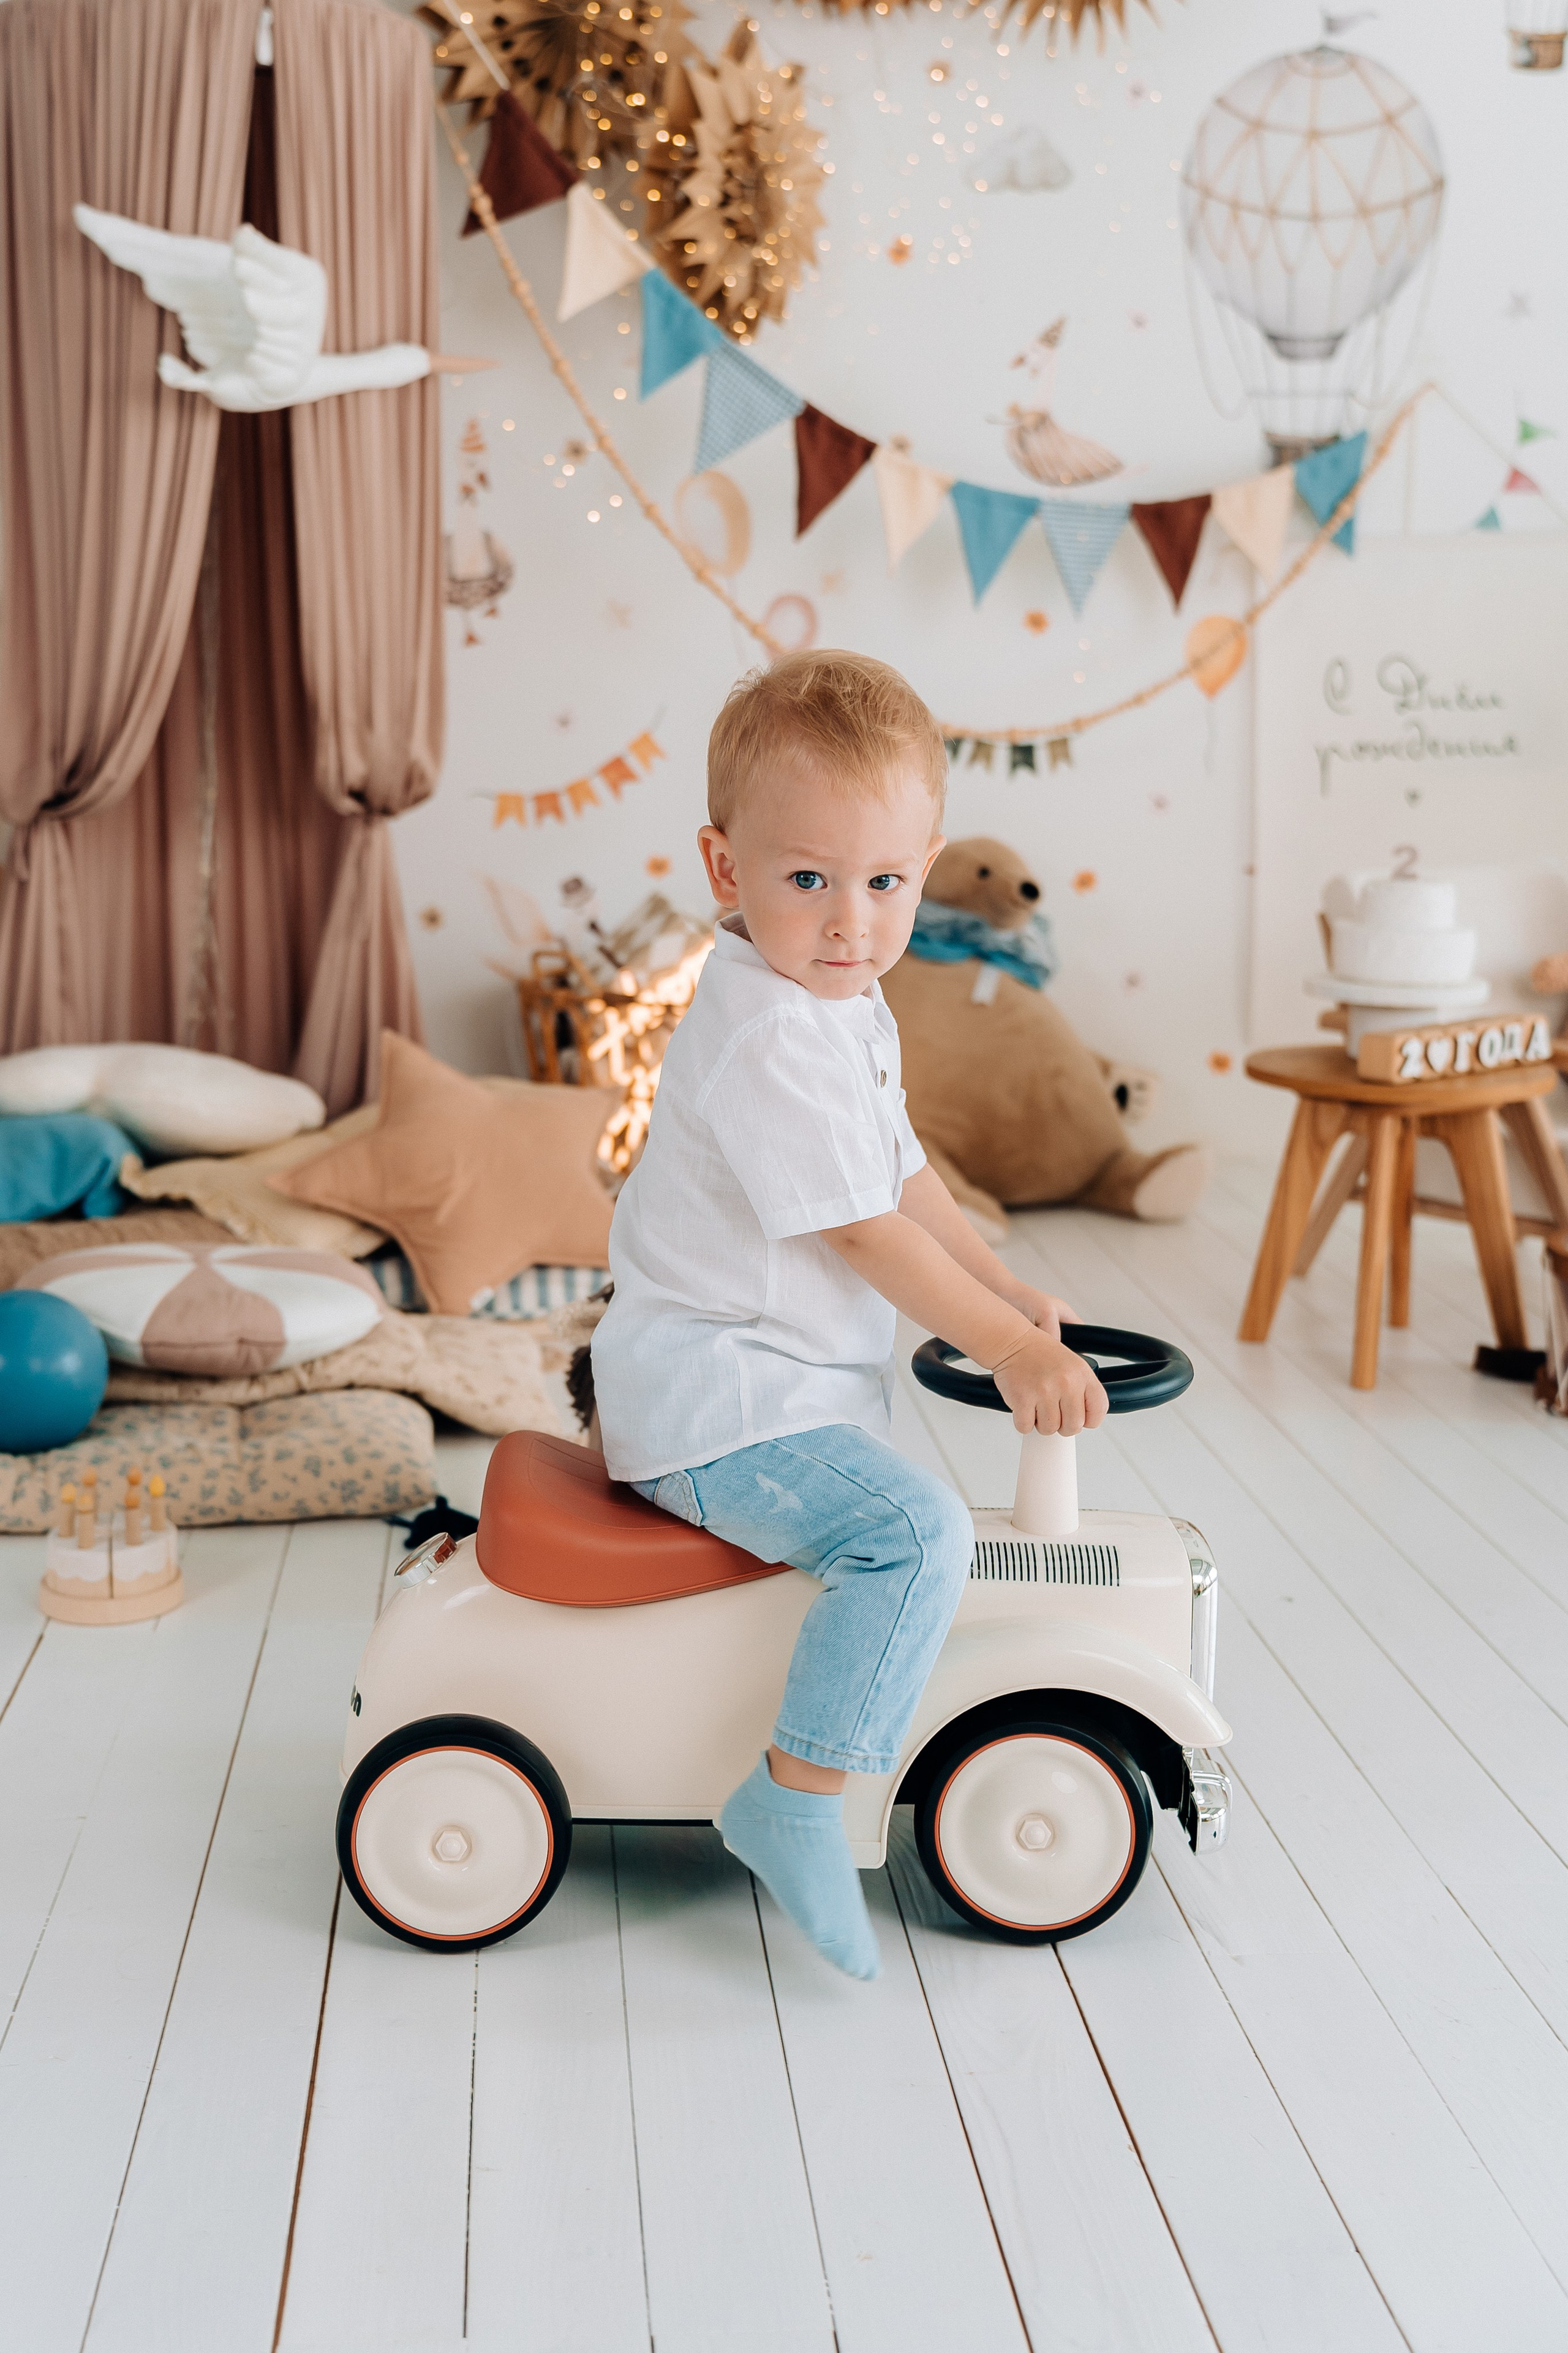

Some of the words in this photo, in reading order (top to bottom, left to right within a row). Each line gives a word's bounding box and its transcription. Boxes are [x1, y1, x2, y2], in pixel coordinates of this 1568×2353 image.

[1392, 845, 1419, 880] 2
[1400, 1038, 1423, 1079] 2
[1453, 1021, 1551, 1072] ГОДА
